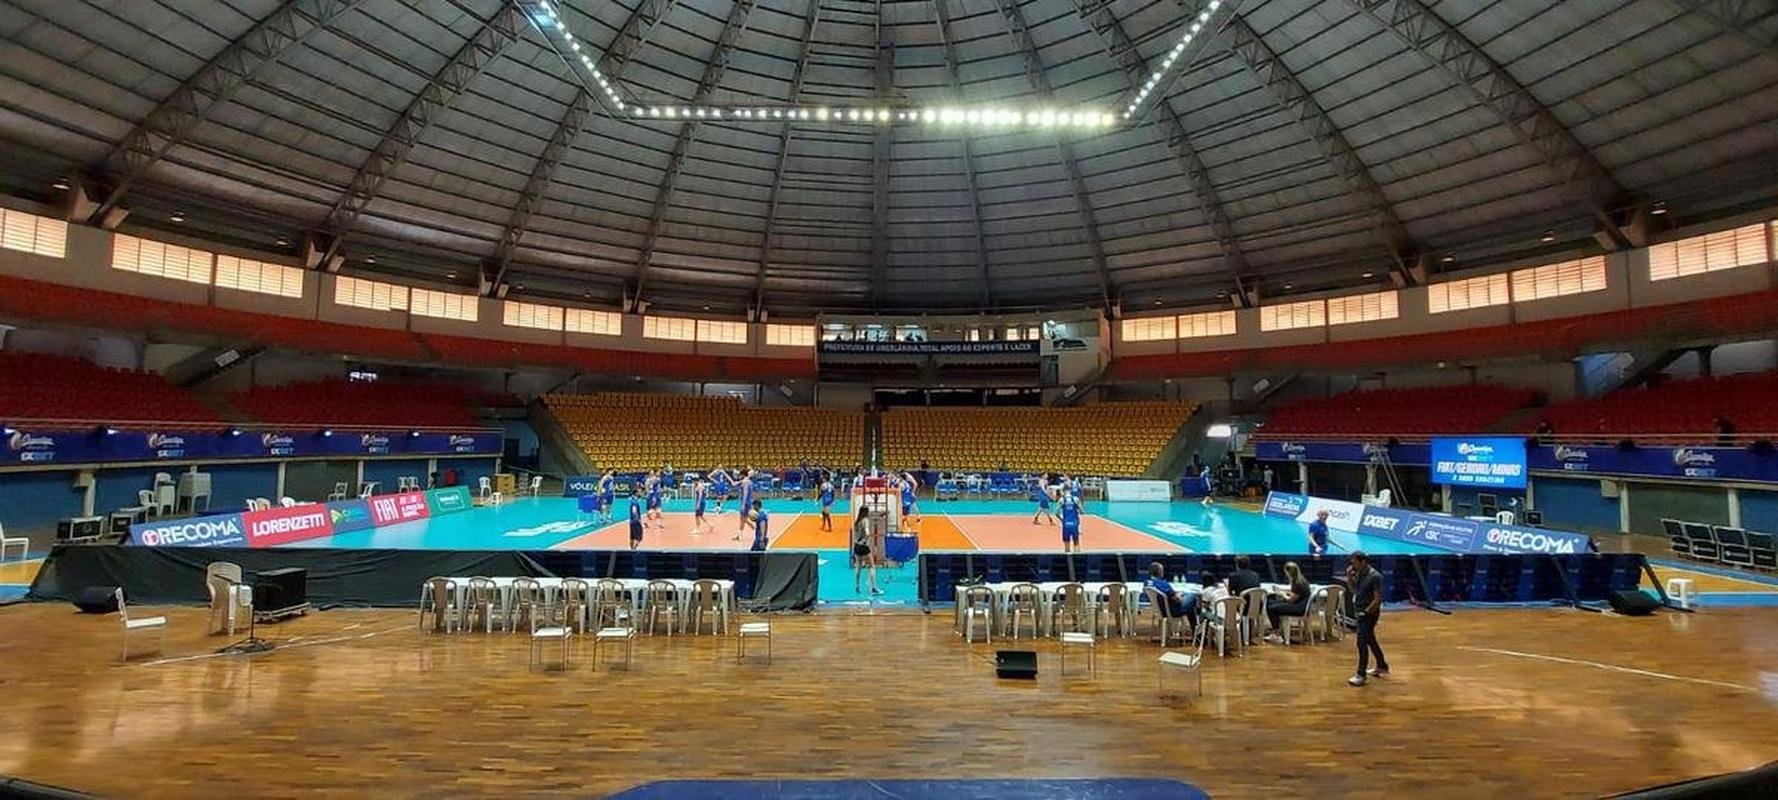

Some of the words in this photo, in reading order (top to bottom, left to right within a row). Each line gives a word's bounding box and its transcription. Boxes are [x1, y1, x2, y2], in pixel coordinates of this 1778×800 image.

[373, 497, 399, 521] FIAT
[157, 520, 240, 544] RECOMA
[252, 512, 325, 536] LORENZETTI
[1363, 514, 1399, 530] 1XBET
[1498, 529, 1574, 553] RECOMA
